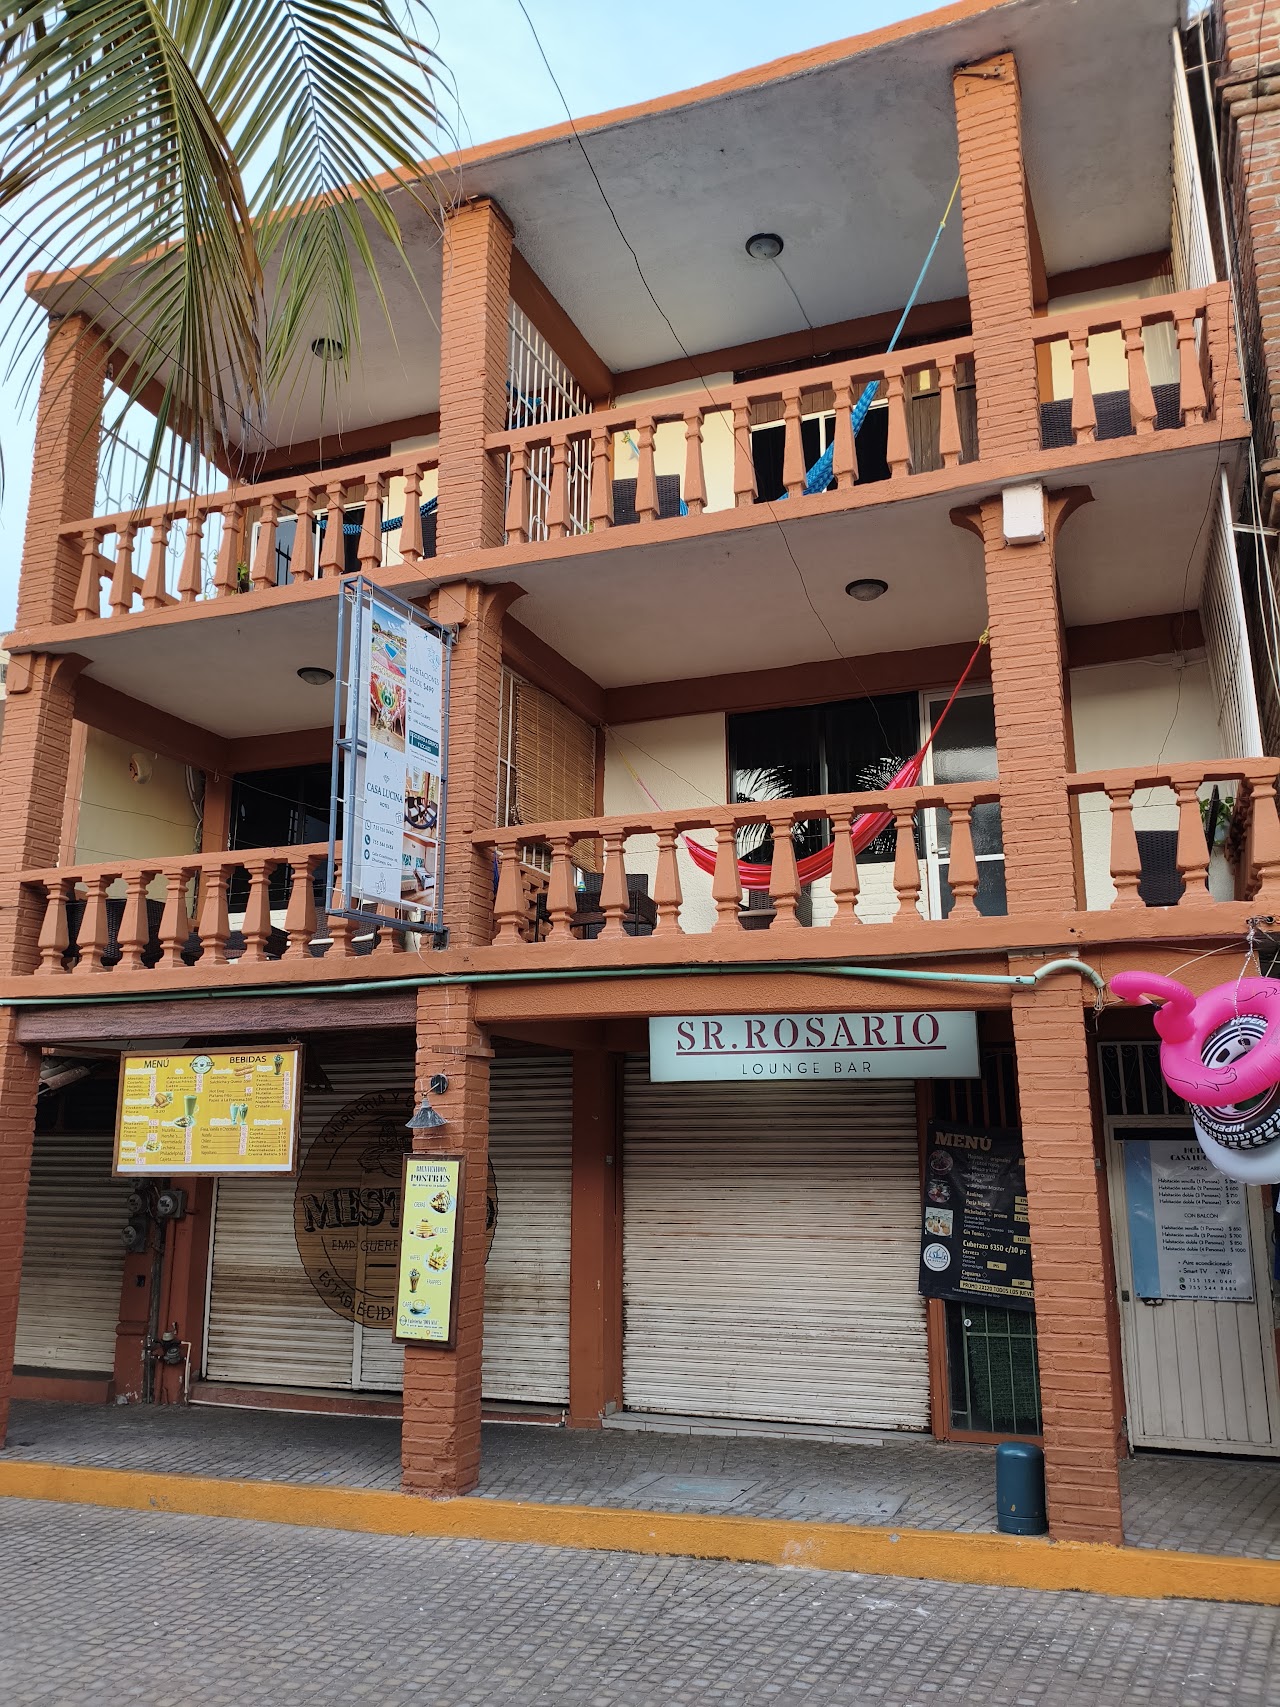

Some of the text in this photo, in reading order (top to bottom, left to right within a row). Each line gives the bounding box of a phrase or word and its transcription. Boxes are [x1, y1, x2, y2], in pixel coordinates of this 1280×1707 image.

[366, 782, 403, 804] CASA LUCINA
[1230, 1016, 1268, 1028] HIPER
[676, 1013, 941, 1051] SR.ROSARIO
[143, 1057, 170, 1069] MENÚ
[229, 1055, 267, 1064] BEBIDAS
[741, 1061, 872, 1075] LOUNGE BAR
[934, 1131, 993, 1151] MENÚ
[410, 1174, 451, 1183] POSTRES
[989, 1243, 1004, 1252] $350
[319, 1270, 394, 1321] ESTABLECID
